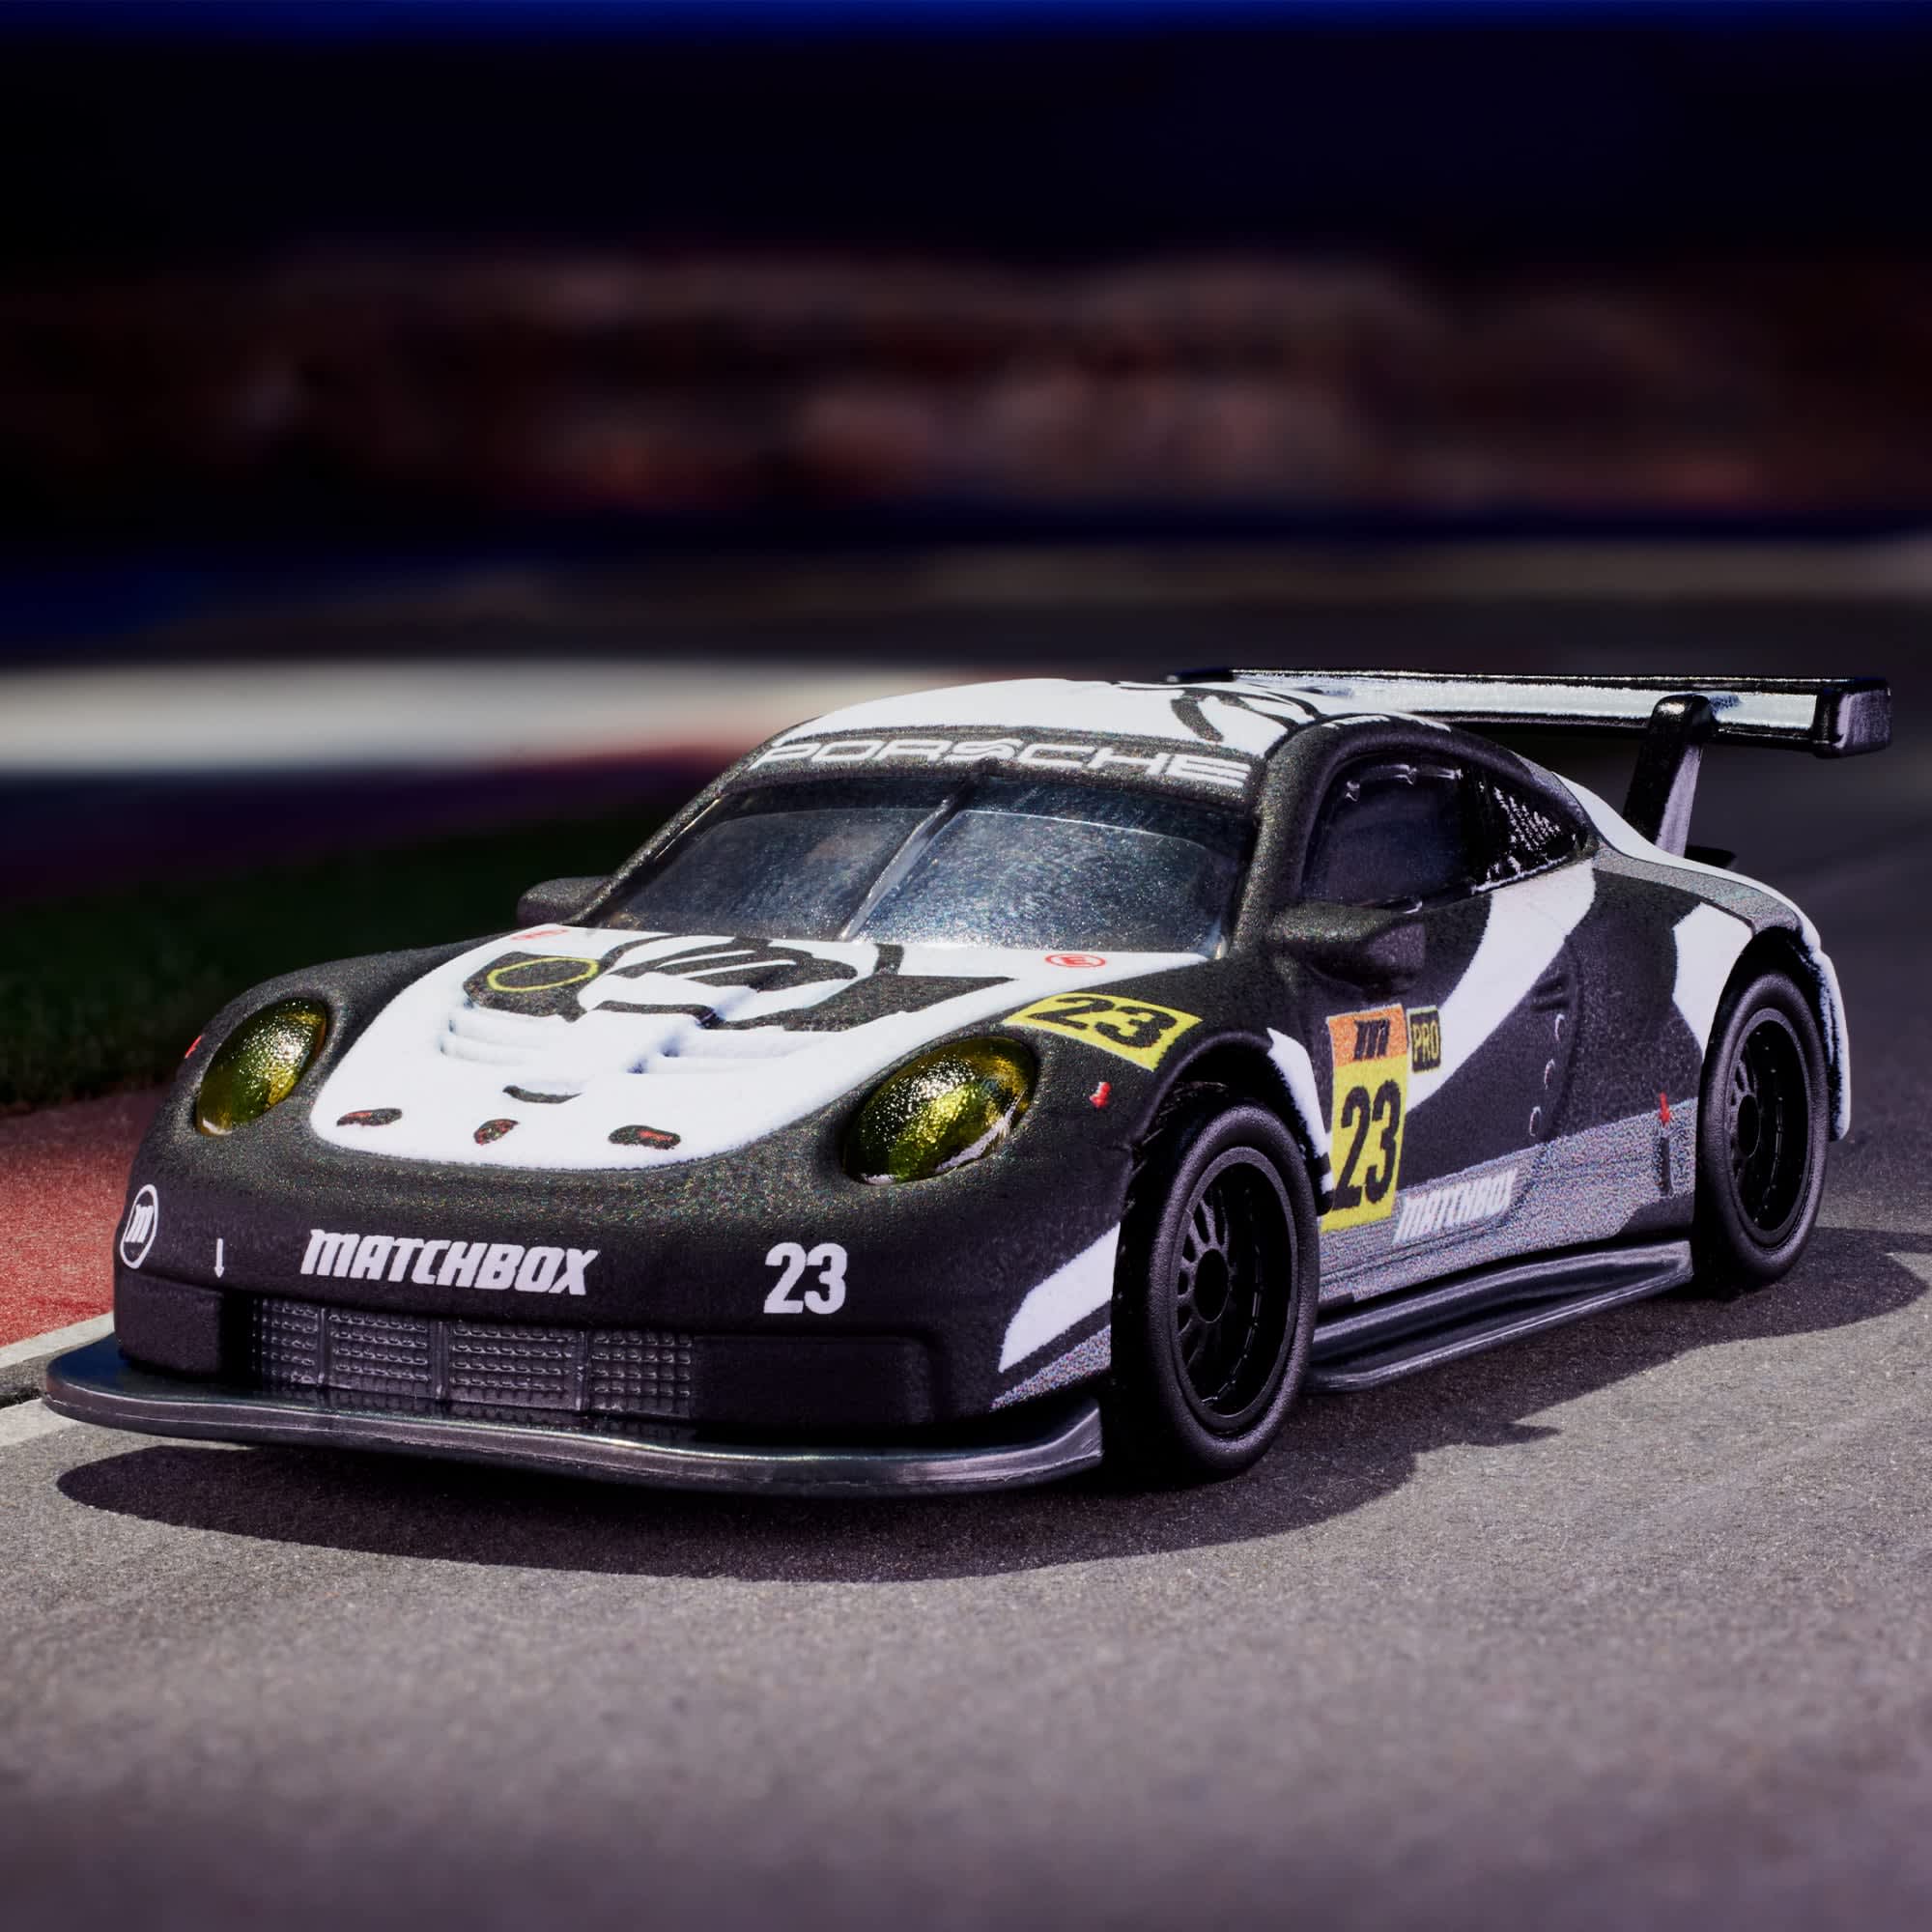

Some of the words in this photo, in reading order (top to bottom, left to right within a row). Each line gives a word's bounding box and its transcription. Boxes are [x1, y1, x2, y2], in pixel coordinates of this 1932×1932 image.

[746, 738, 1252, 788] PORSCHE
[1027, 996, 1179, 1049] 23
[1410, 1019, 1441, 1063] PRO
[1332, 1078, 1401, 1209] 23
[299, 1229, 599, 1295] MATCHBOX
[763, 1242, 848, 1315] 23
